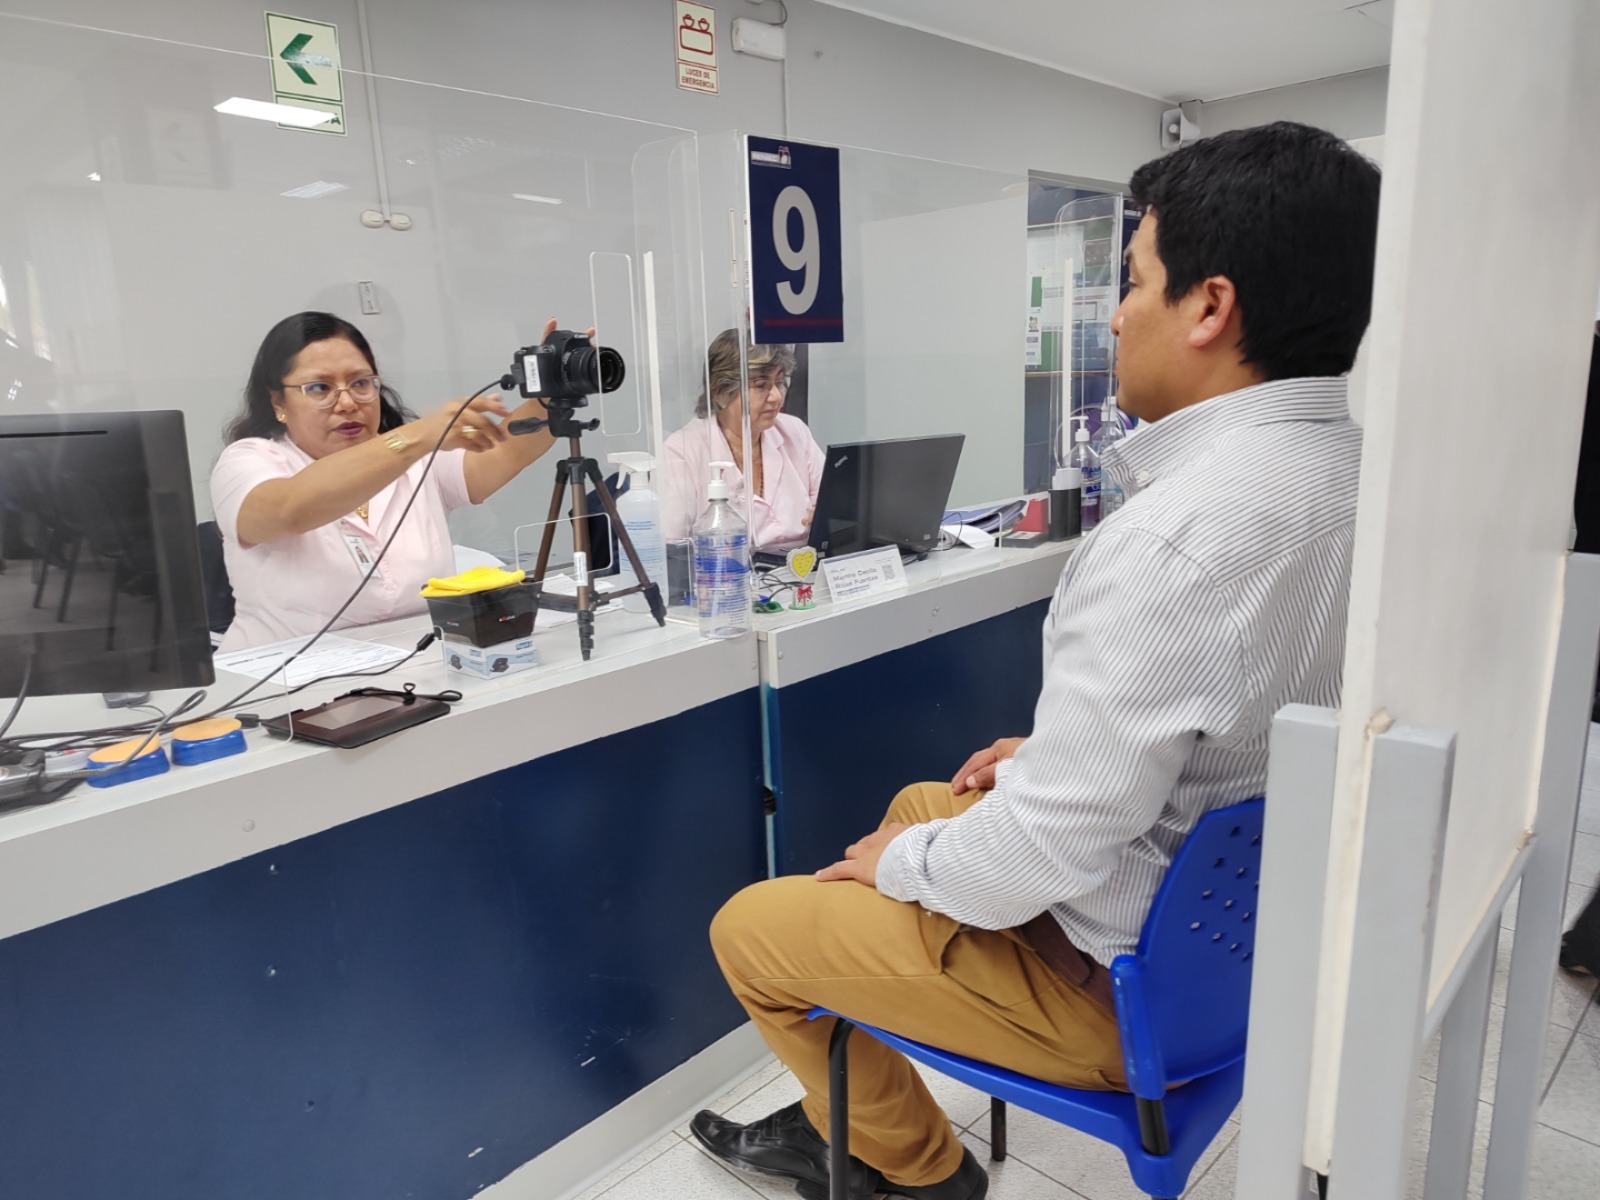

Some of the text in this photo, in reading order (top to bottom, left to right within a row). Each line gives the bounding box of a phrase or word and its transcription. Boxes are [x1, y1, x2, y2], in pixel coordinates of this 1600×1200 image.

[685, 67, 711, 79] LUCES DE
[681, 76, 715, 89] EMERGENCIA
[772, 185, 821, 315] 9
